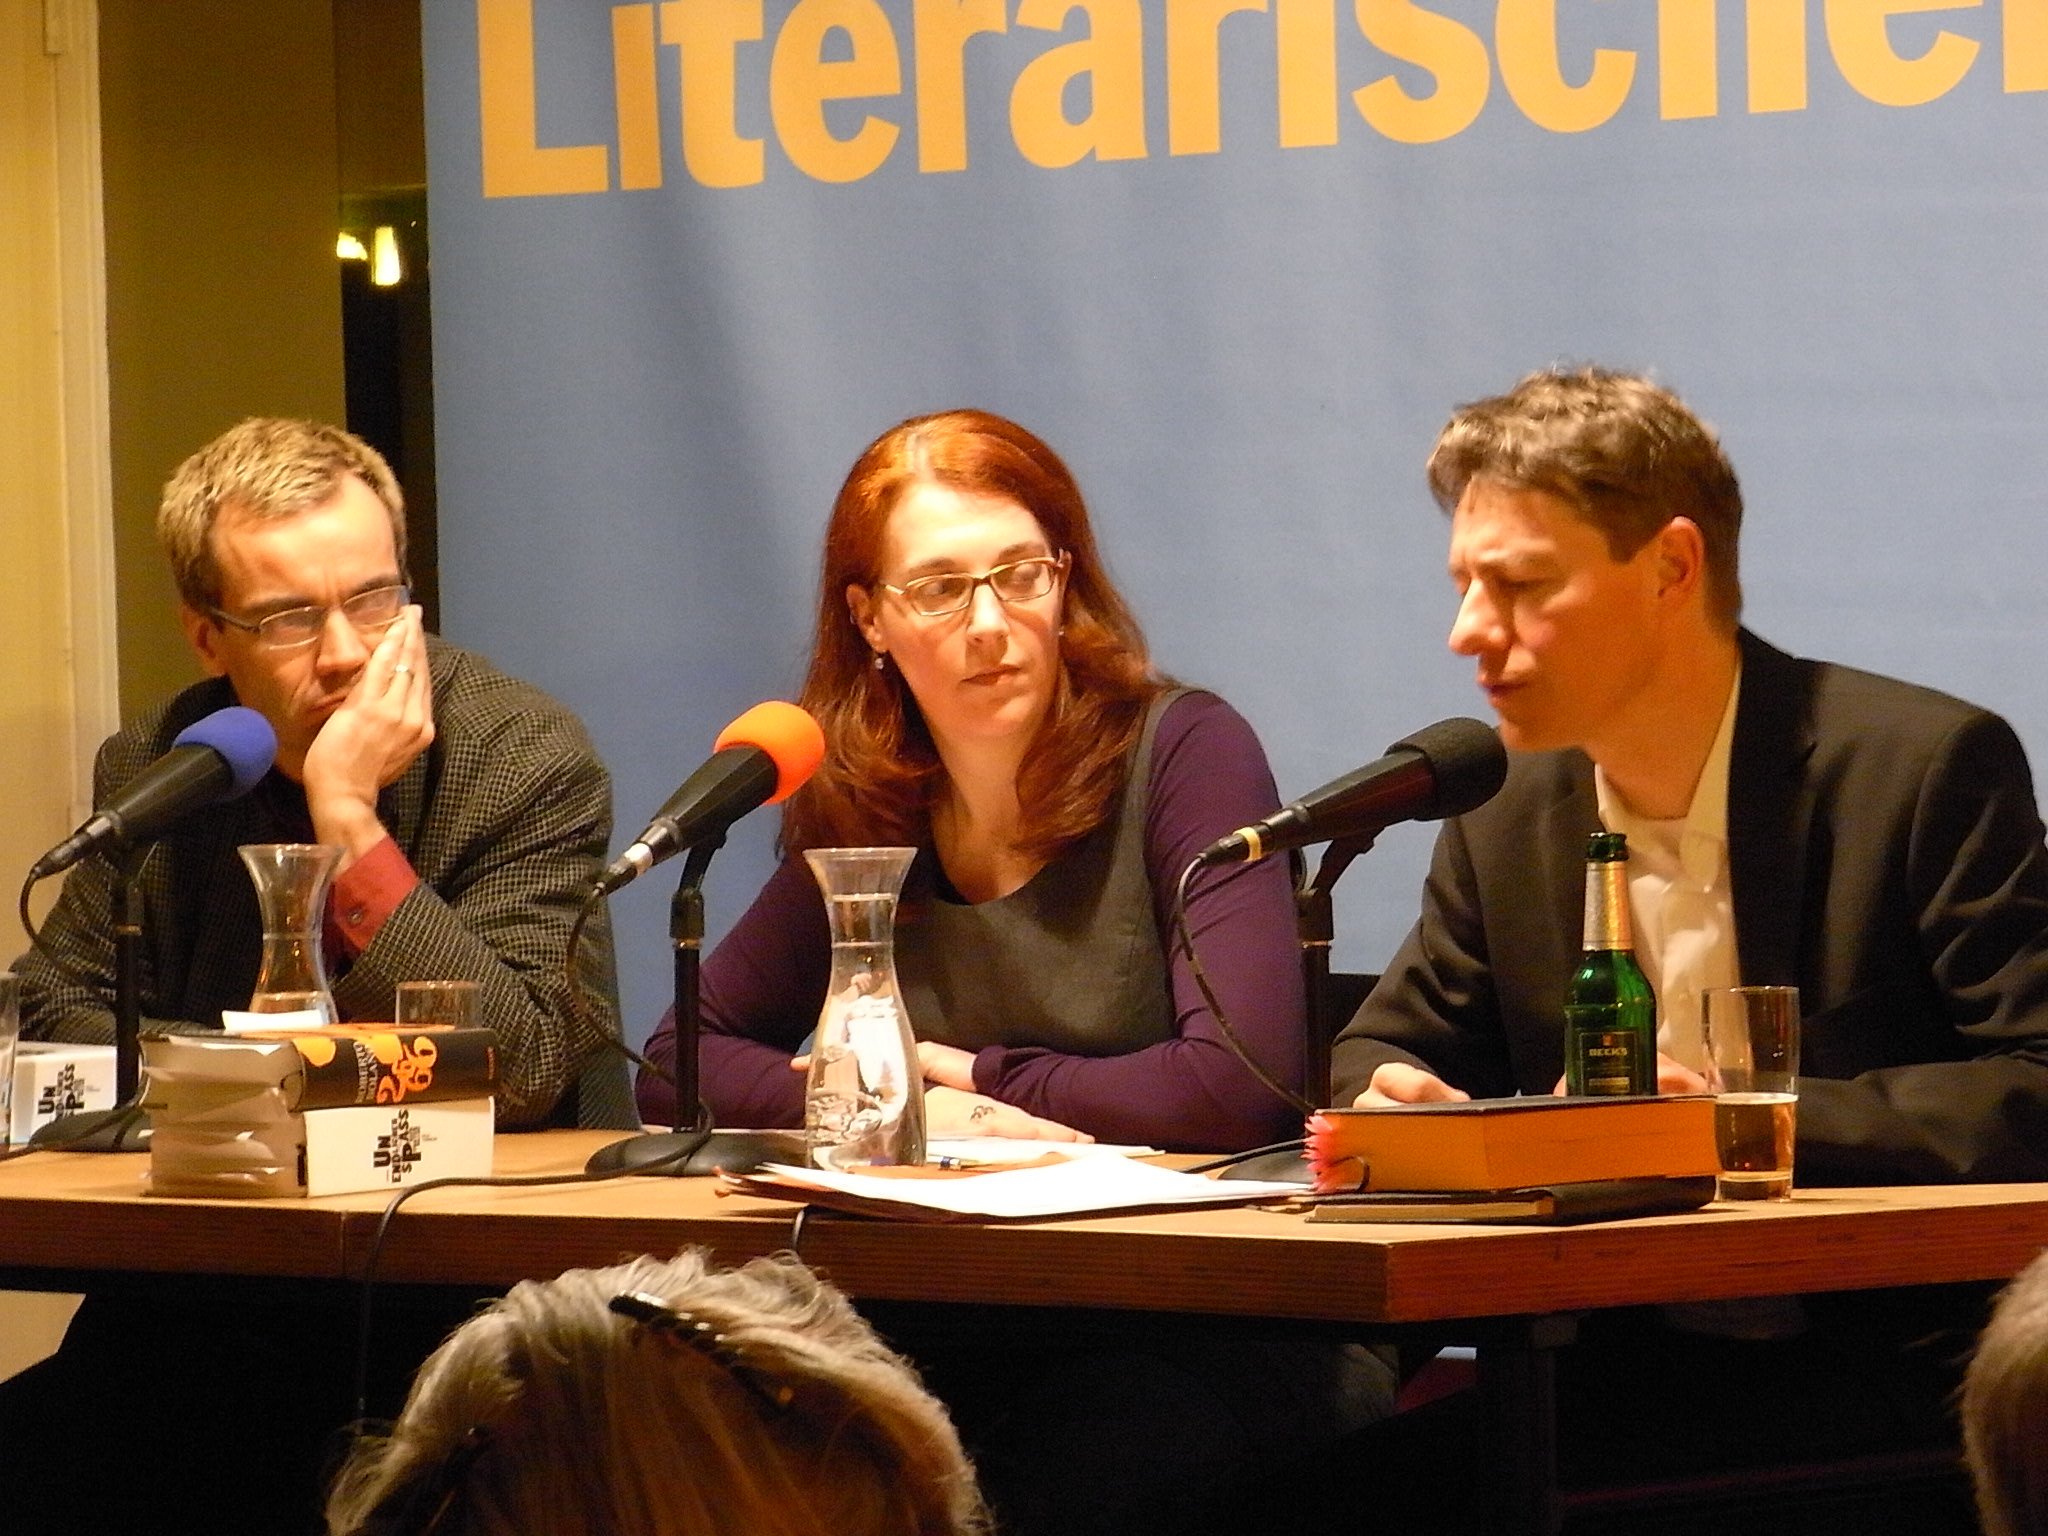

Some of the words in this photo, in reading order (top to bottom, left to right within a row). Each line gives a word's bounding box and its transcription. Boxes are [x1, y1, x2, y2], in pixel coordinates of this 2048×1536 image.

[478, 0, 2048, 198] Literarisce
[37, 1085, 56, 1115] UN
[373, 1135, 391, 1168] UN
[398, 1109, 421, 1174] SPASS
